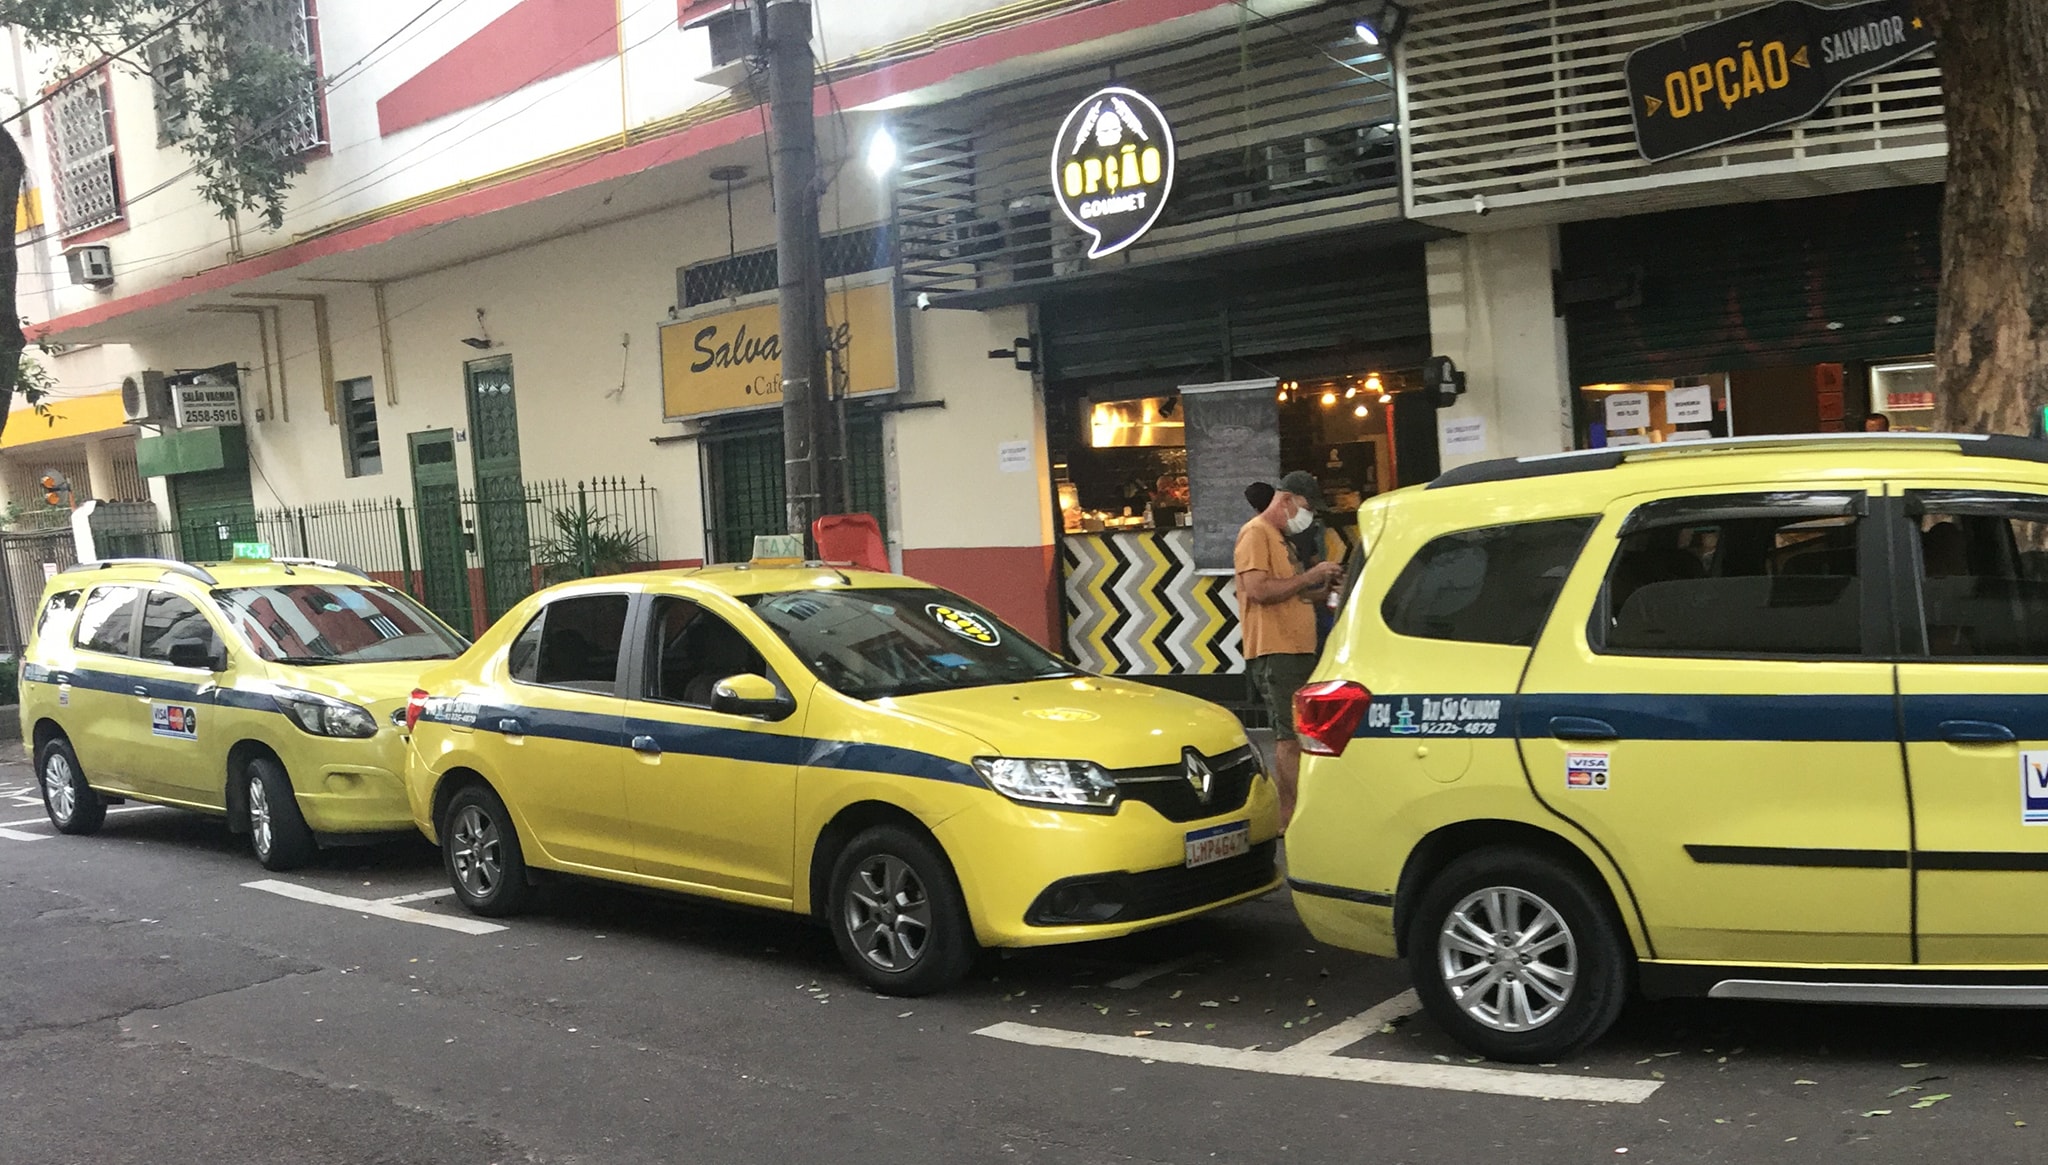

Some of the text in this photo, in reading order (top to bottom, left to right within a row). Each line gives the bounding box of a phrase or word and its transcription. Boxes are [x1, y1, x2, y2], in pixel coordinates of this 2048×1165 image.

[1665, 15, 1906, 119] OPÇÃO SALVADOR
[1064, 143, 1161, 197] OPÇÃO
[690, 321, 852, 373] Salvae
[182, 390, 205, 402] SALÃO
[186, 409, 238, 423] 2558-5916
[758, 537, 798, 557] TAXI
[1573, 759, 1606, 767] VISA
